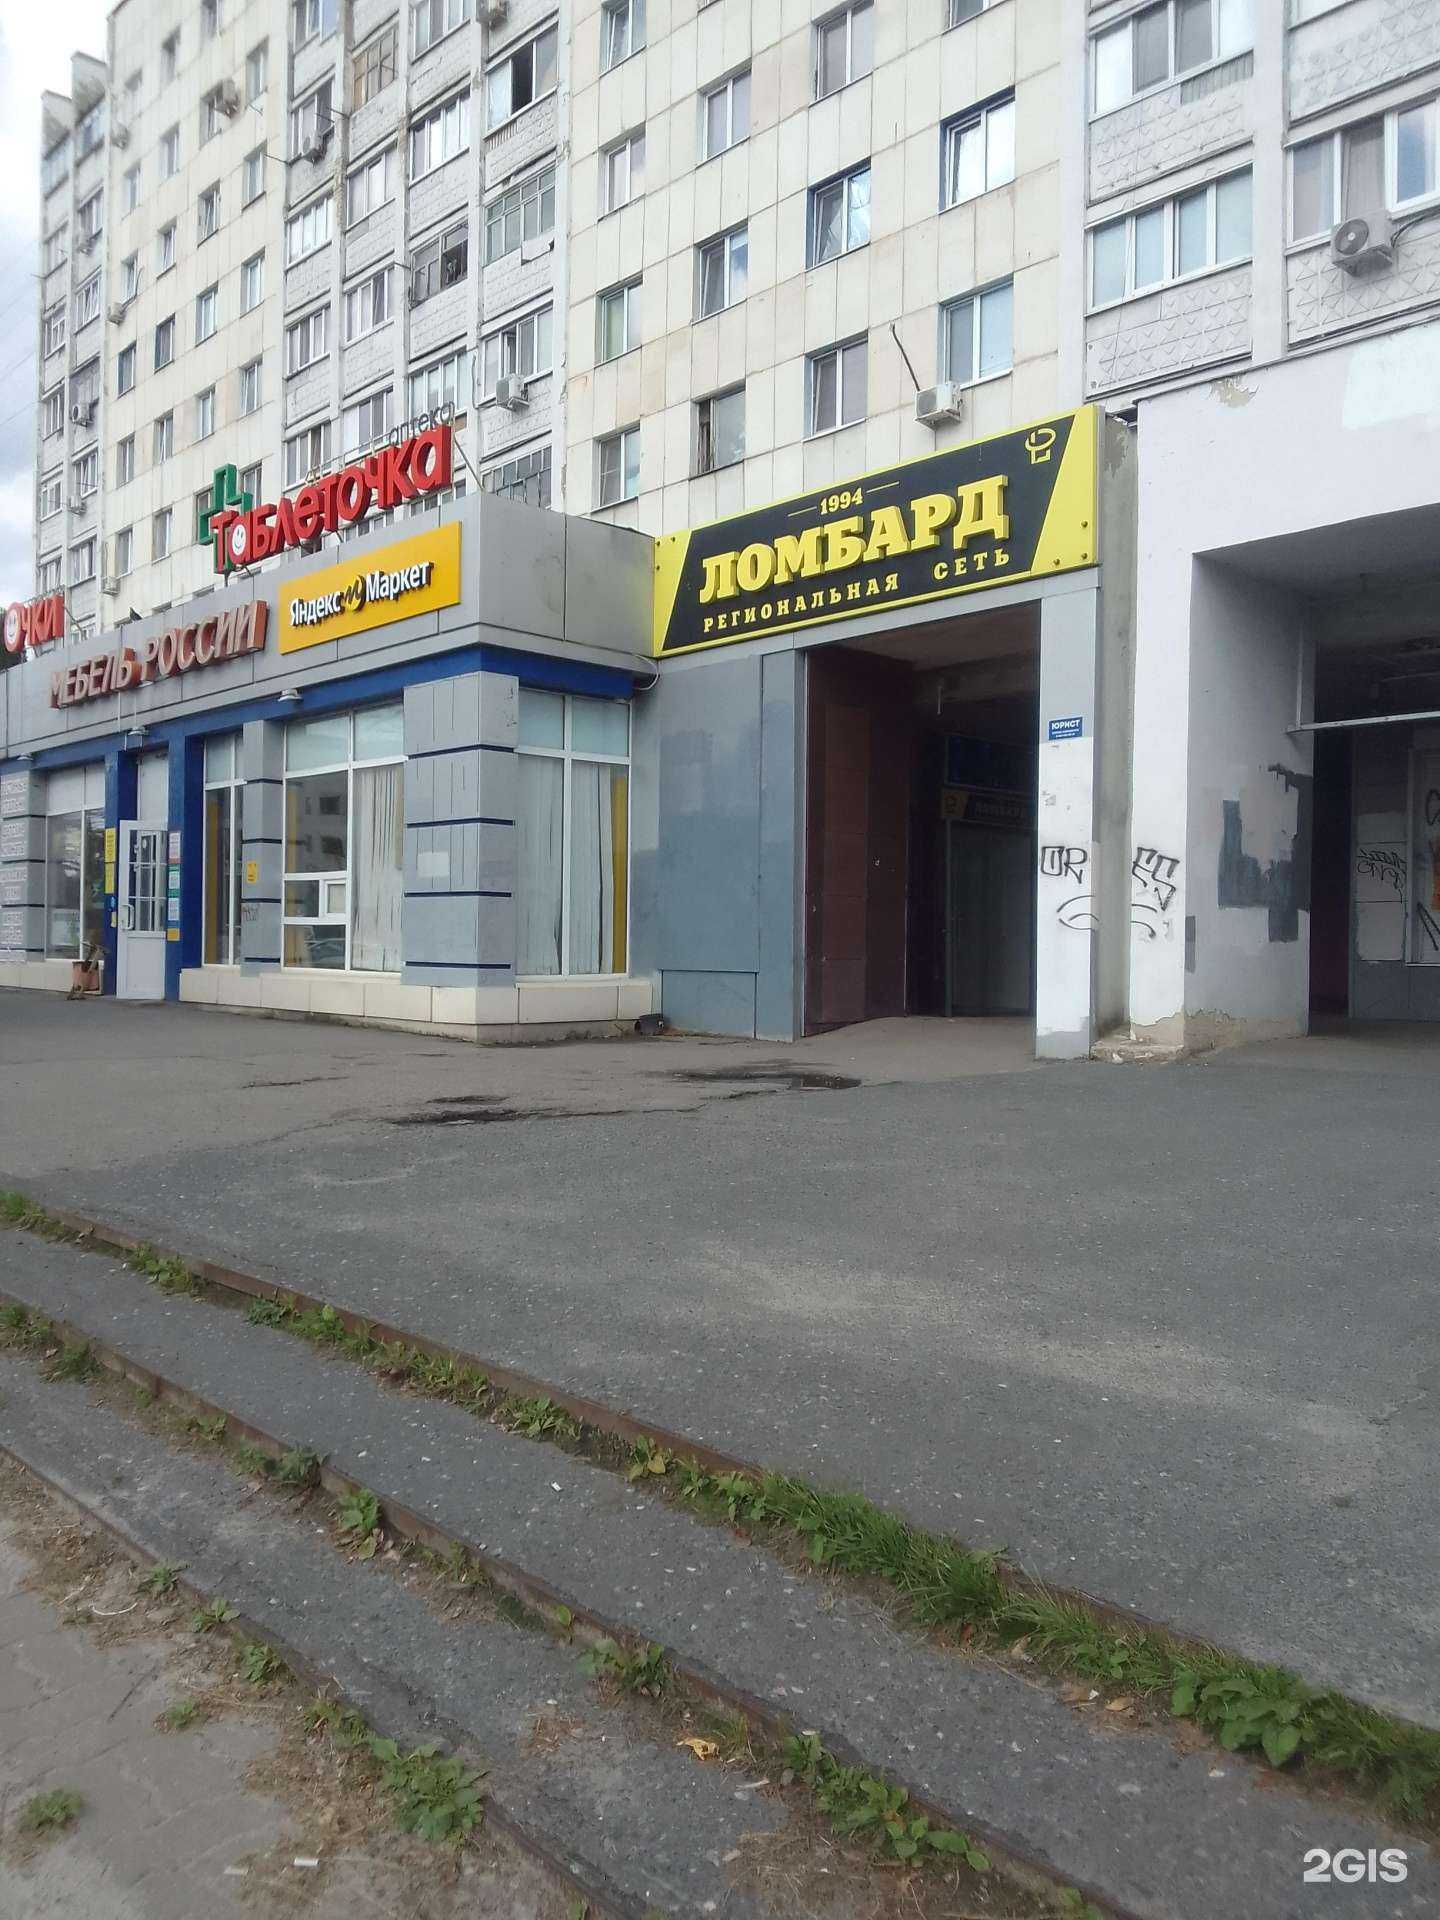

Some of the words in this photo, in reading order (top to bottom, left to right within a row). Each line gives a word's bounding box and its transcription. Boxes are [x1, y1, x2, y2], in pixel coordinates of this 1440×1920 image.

[699, 474, 1010, 604] ЛОМБАРД
[819, 487, 864, 515] 1994
[289, 590, 342, 628] Яндекс
[364, 561, 434, 602] Маркет
[703, 574, 899, 633] РЕГИОНАЛЬНАЯ
[934, 548, 1011, 581] СЕТЬ
[50, 647, 141, 709] МЕБЕЛЬ
[140, 600, 268, 682] РОССИИ
[1051, 719, 1080, 731] ЮРИСТ
